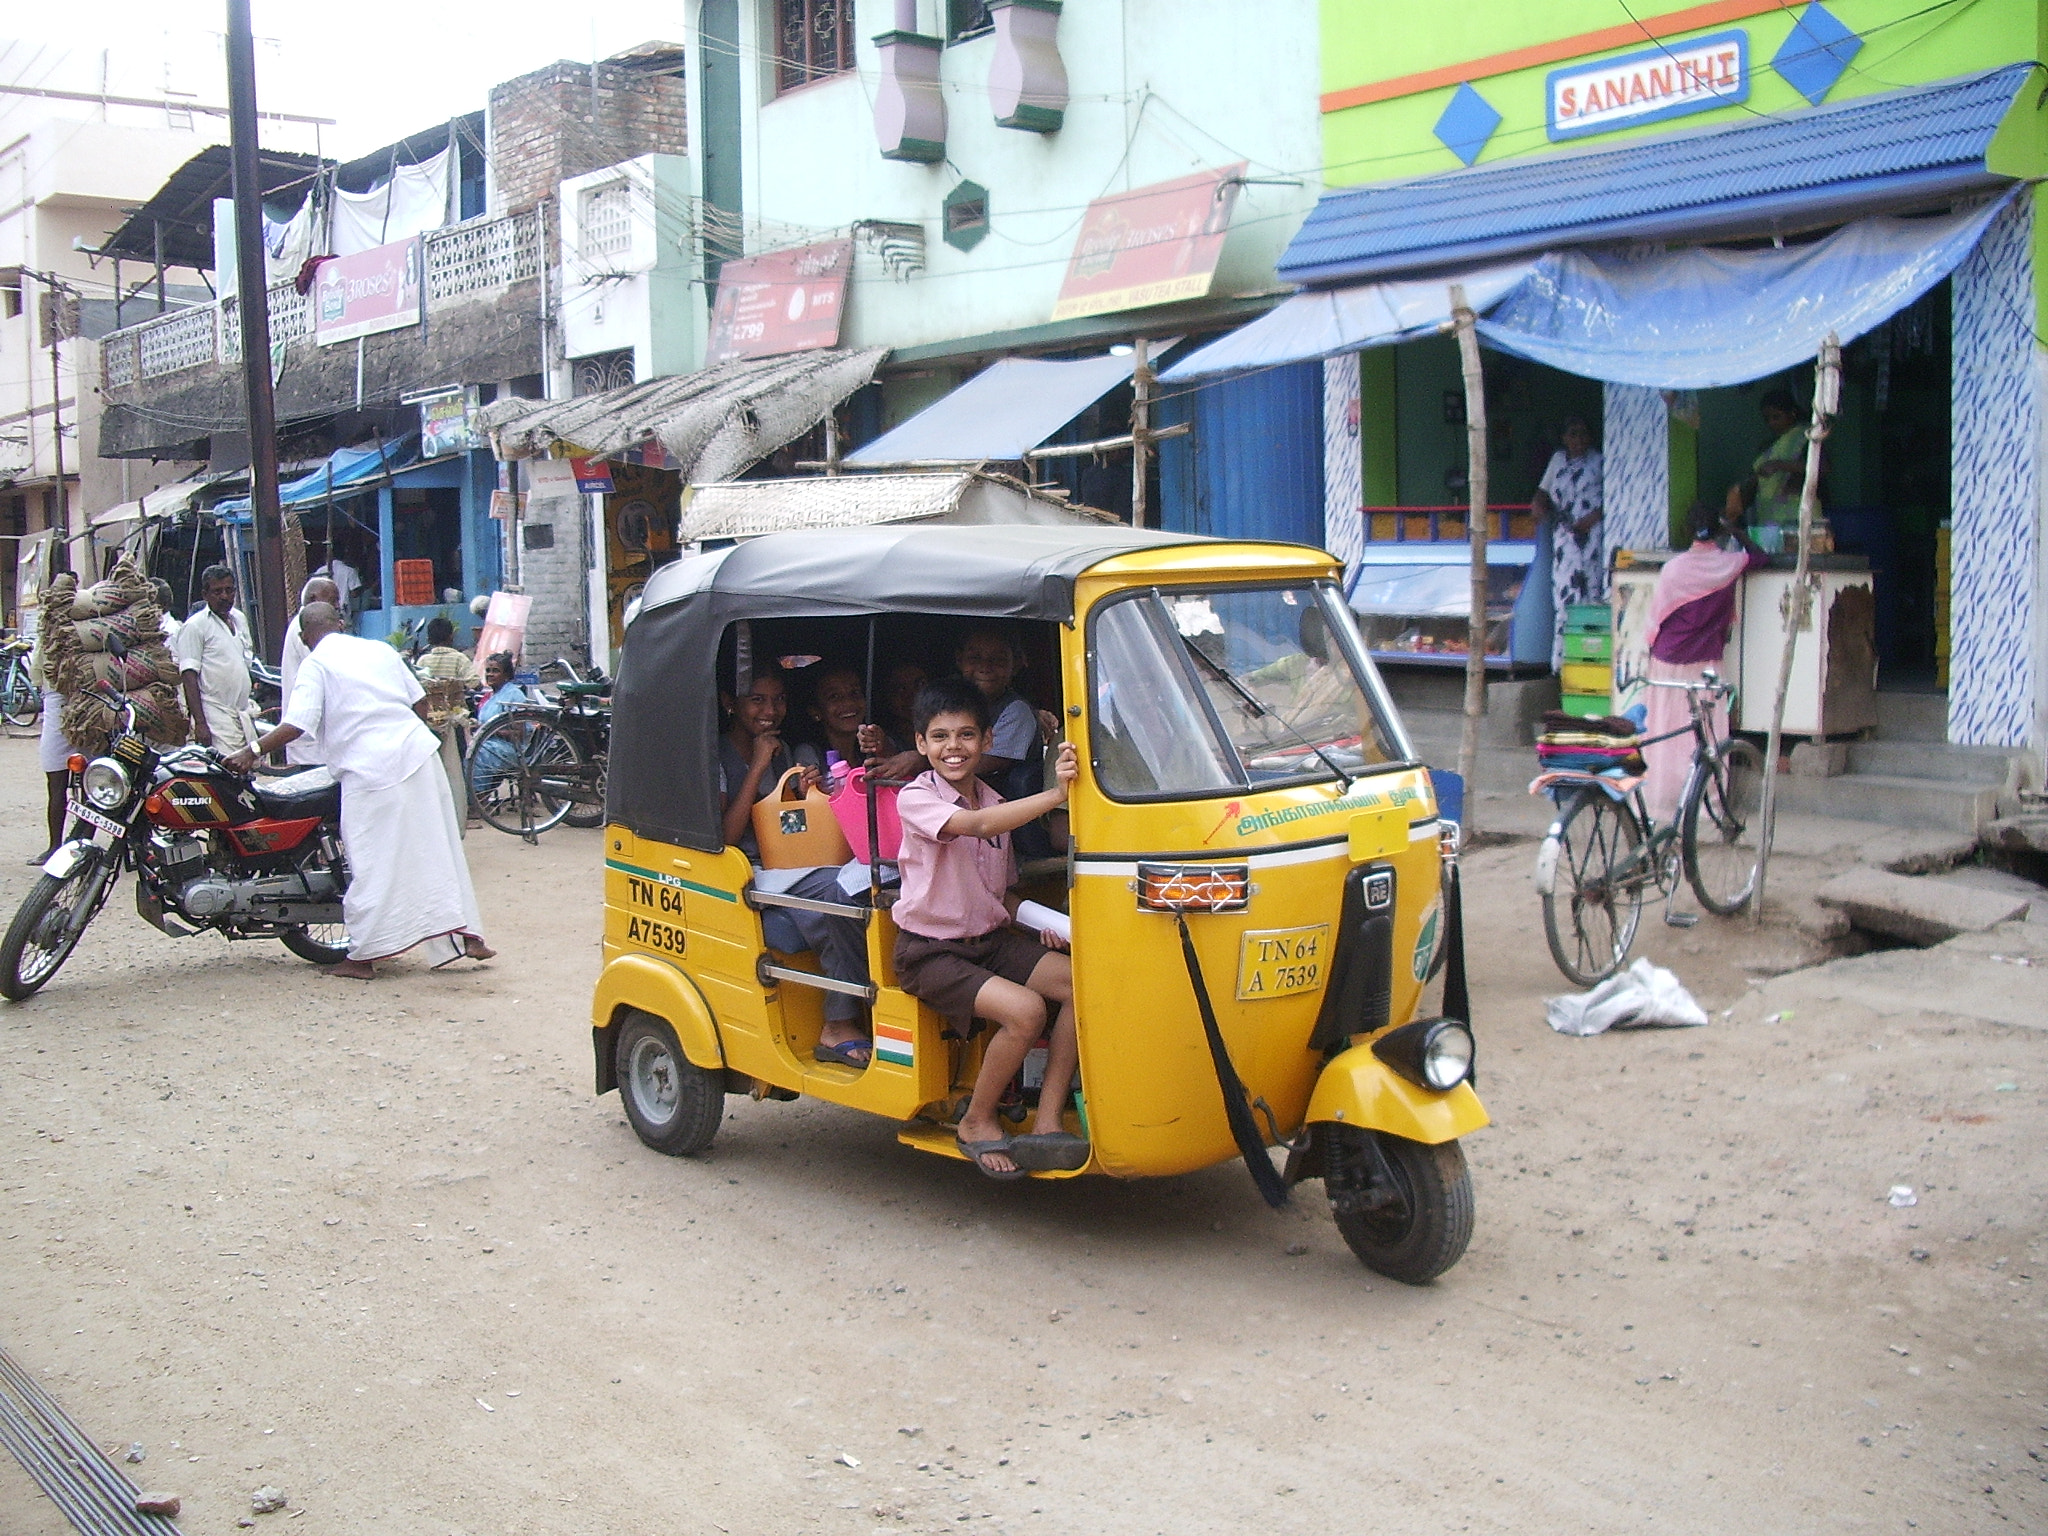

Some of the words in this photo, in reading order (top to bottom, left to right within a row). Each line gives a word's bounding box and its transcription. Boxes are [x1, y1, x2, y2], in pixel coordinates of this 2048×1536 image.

[812, 291, 835, 307] MTS
[171, 797, 212, 806] SUZUKI
[658, 873, 682, 887] LPG
[628, 878, 653, 907] TN
[660, 887, 683, 915] 64
[628, 916, 685, 954] A7539
[1258, 939, 1291, 962] TN
[1295, 935, 1317, 959] 64
[1248, 970, 1264, 992] A
[1274, 964, 1318, 990] 7539
